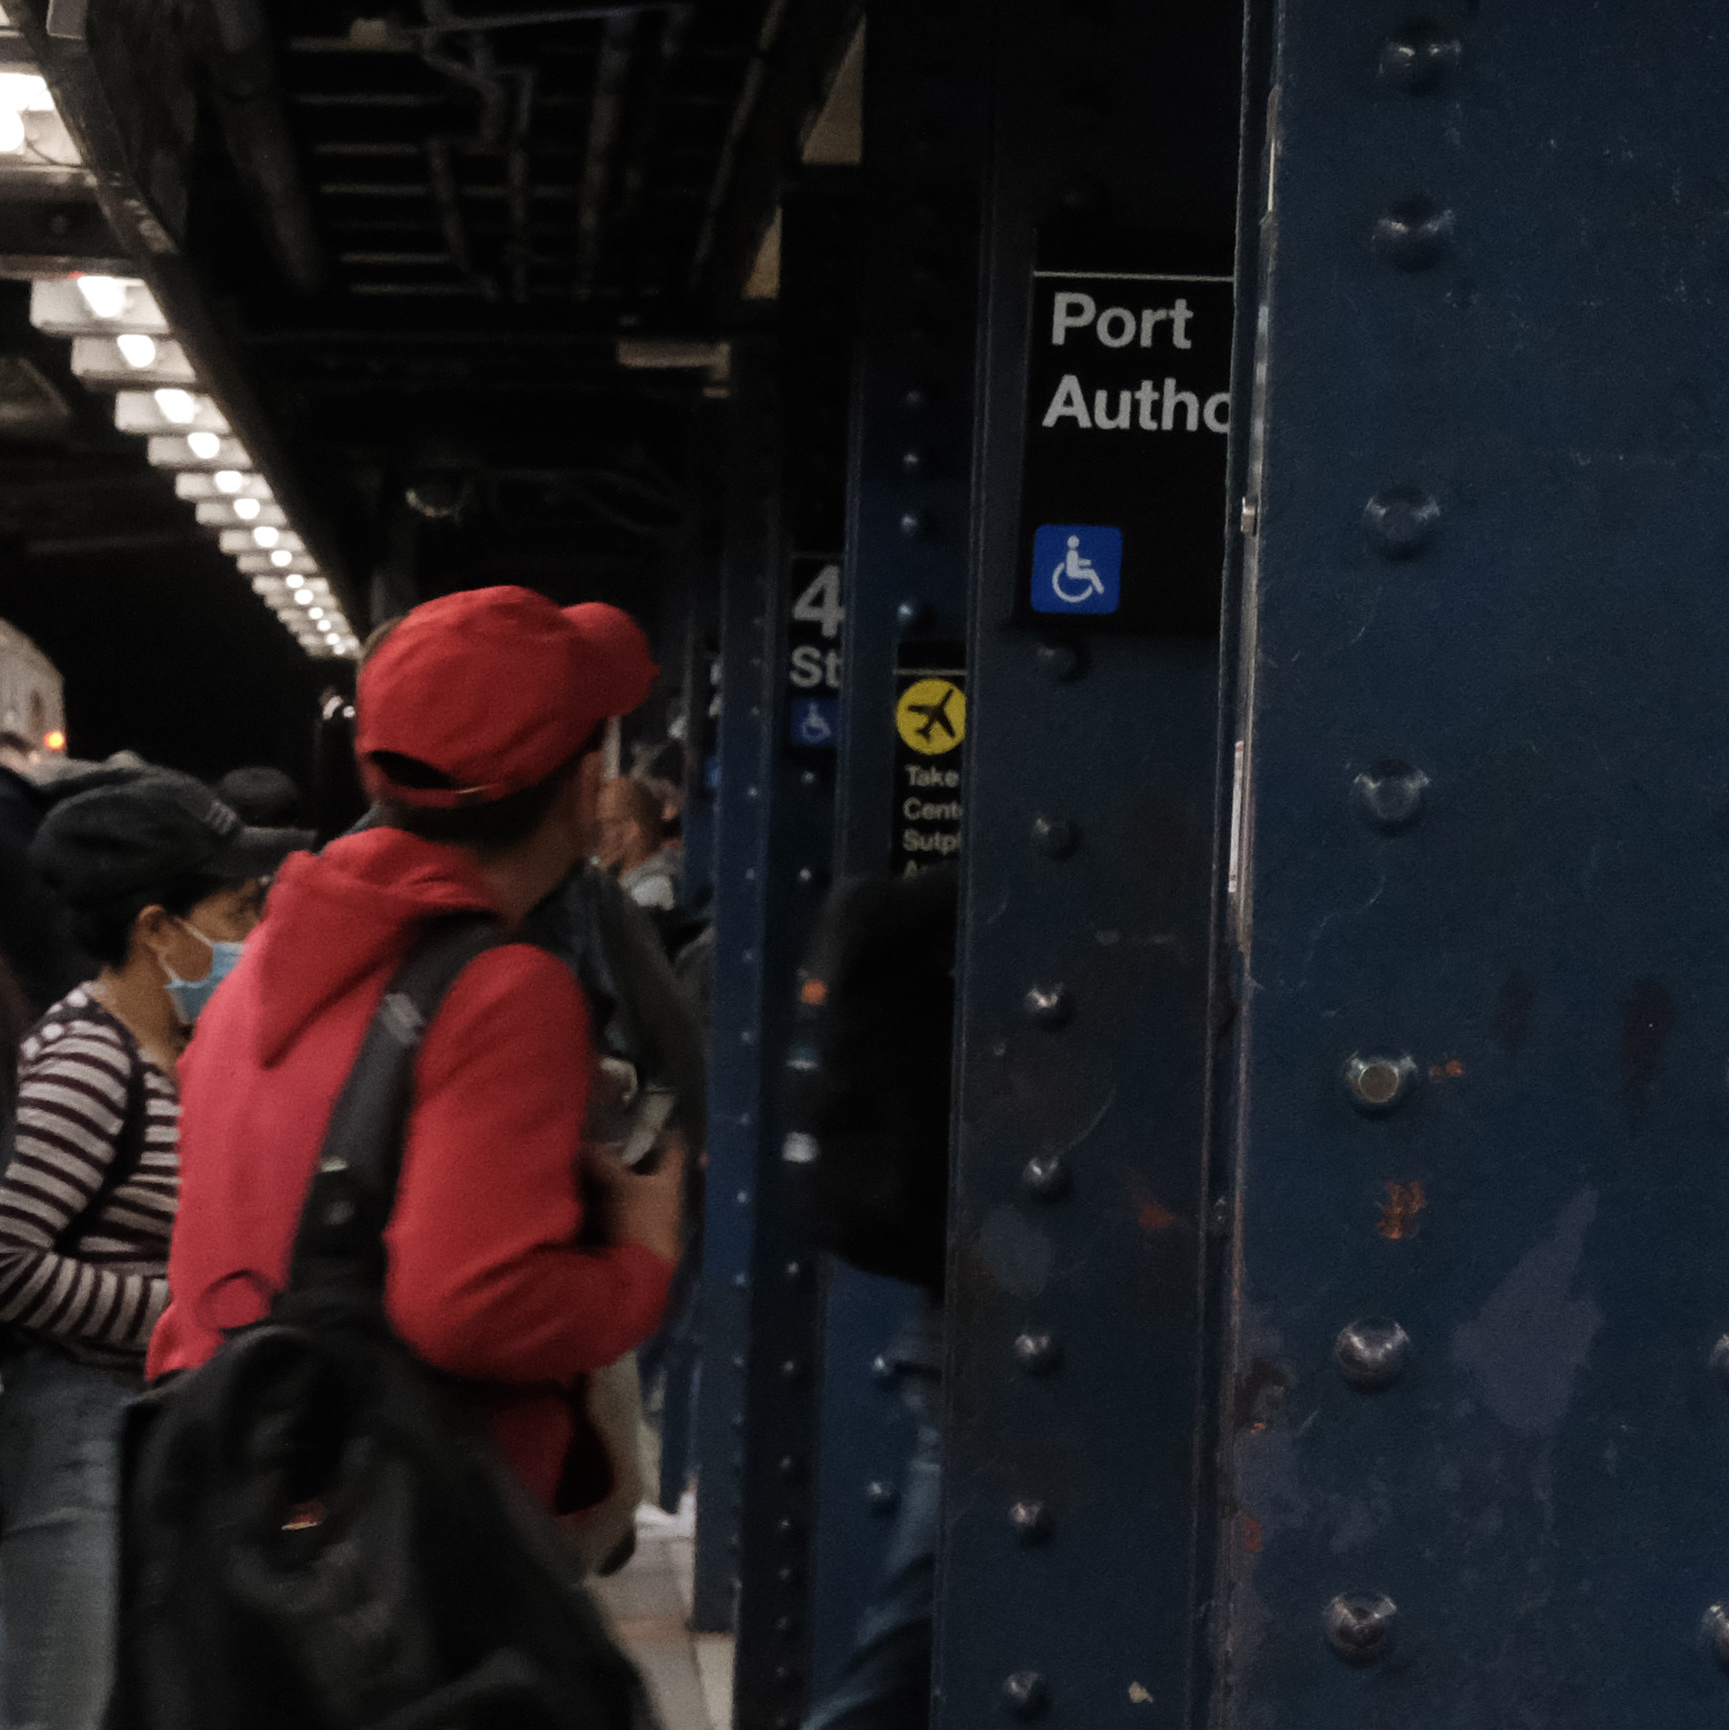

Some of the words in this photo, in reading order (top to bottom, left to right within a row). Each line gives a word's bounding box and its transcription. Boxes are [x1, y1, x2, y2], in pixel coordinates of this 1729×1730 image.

[1051, 291, 1194, 350] Port
[1041, 373, 1231, 434] Autho
[789, 643, 844, 688] St
[904, 764, 960, 789] Take
